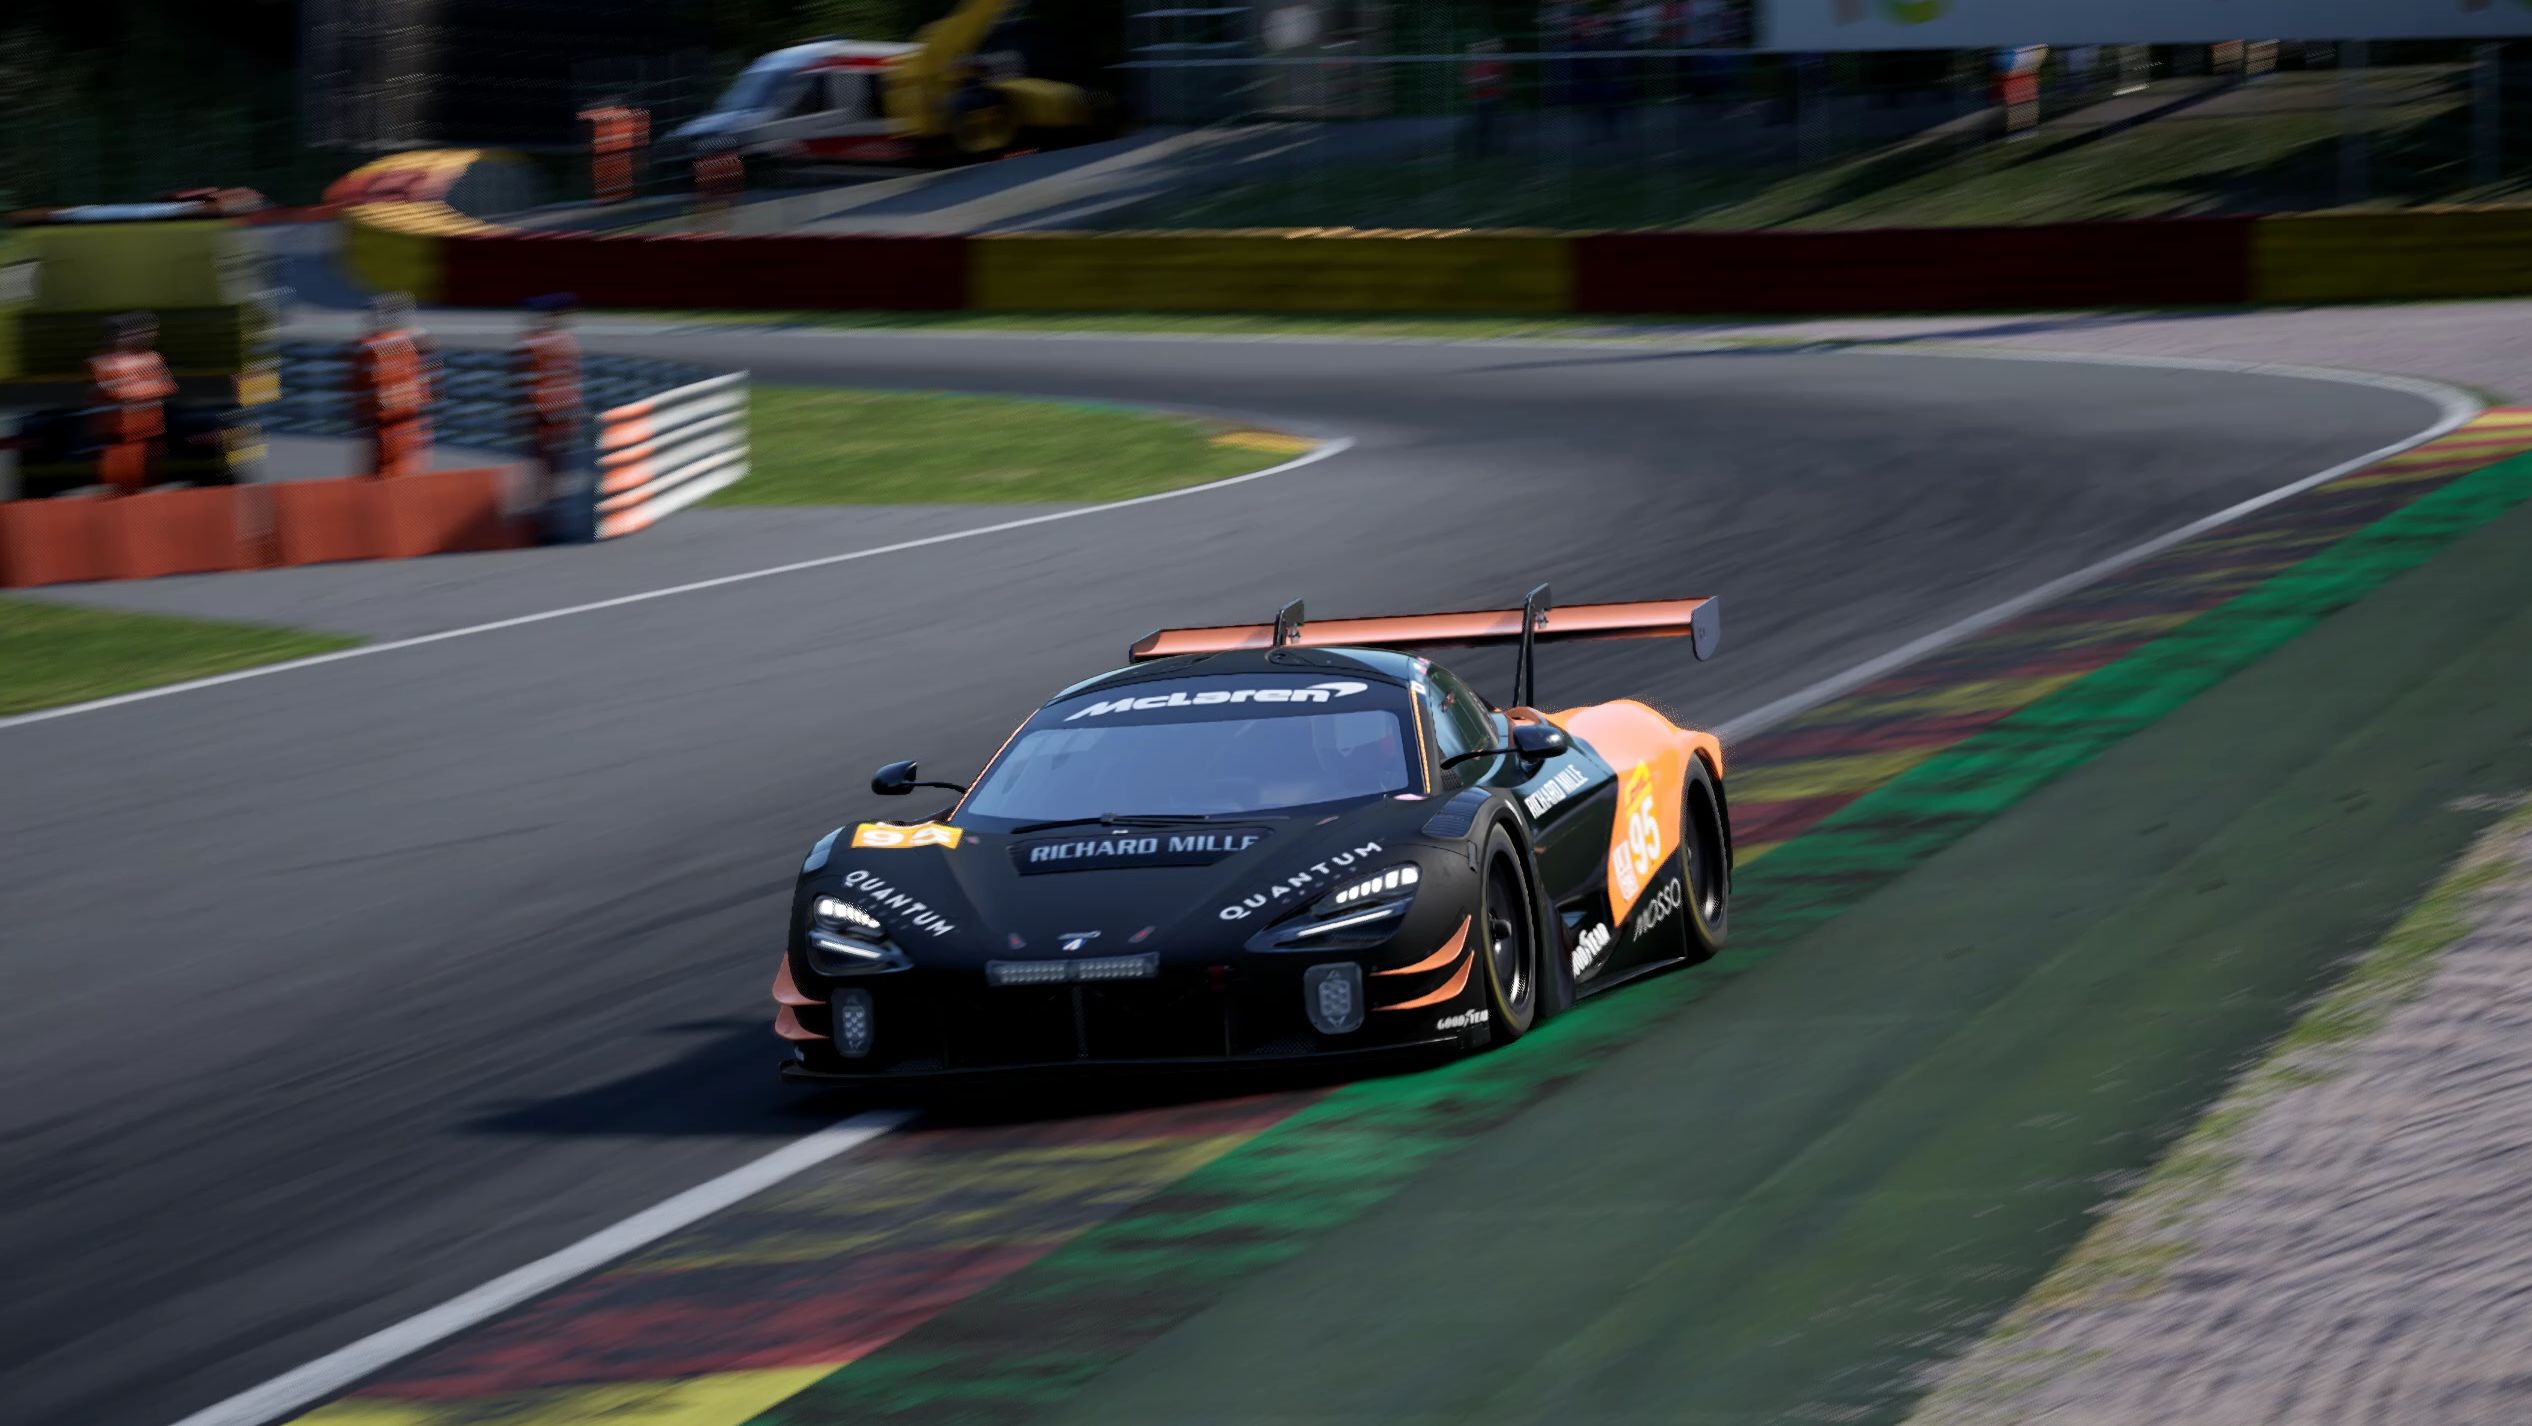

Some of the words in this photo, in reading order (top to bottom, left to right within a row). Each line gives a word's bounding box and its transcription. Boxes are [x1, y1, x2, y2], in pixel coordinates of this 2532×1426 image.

[1063, 688, 1332, 722] McLaren
[1524, 779, 1567, 820] RICHARD
[1030, 837, 1158, 863] RICHARD
[1628, 794, 1661, 875] 95
[843, 870, 955, 937] QUANTUM
[1218, 841, 1383, 921] QUANTUM
